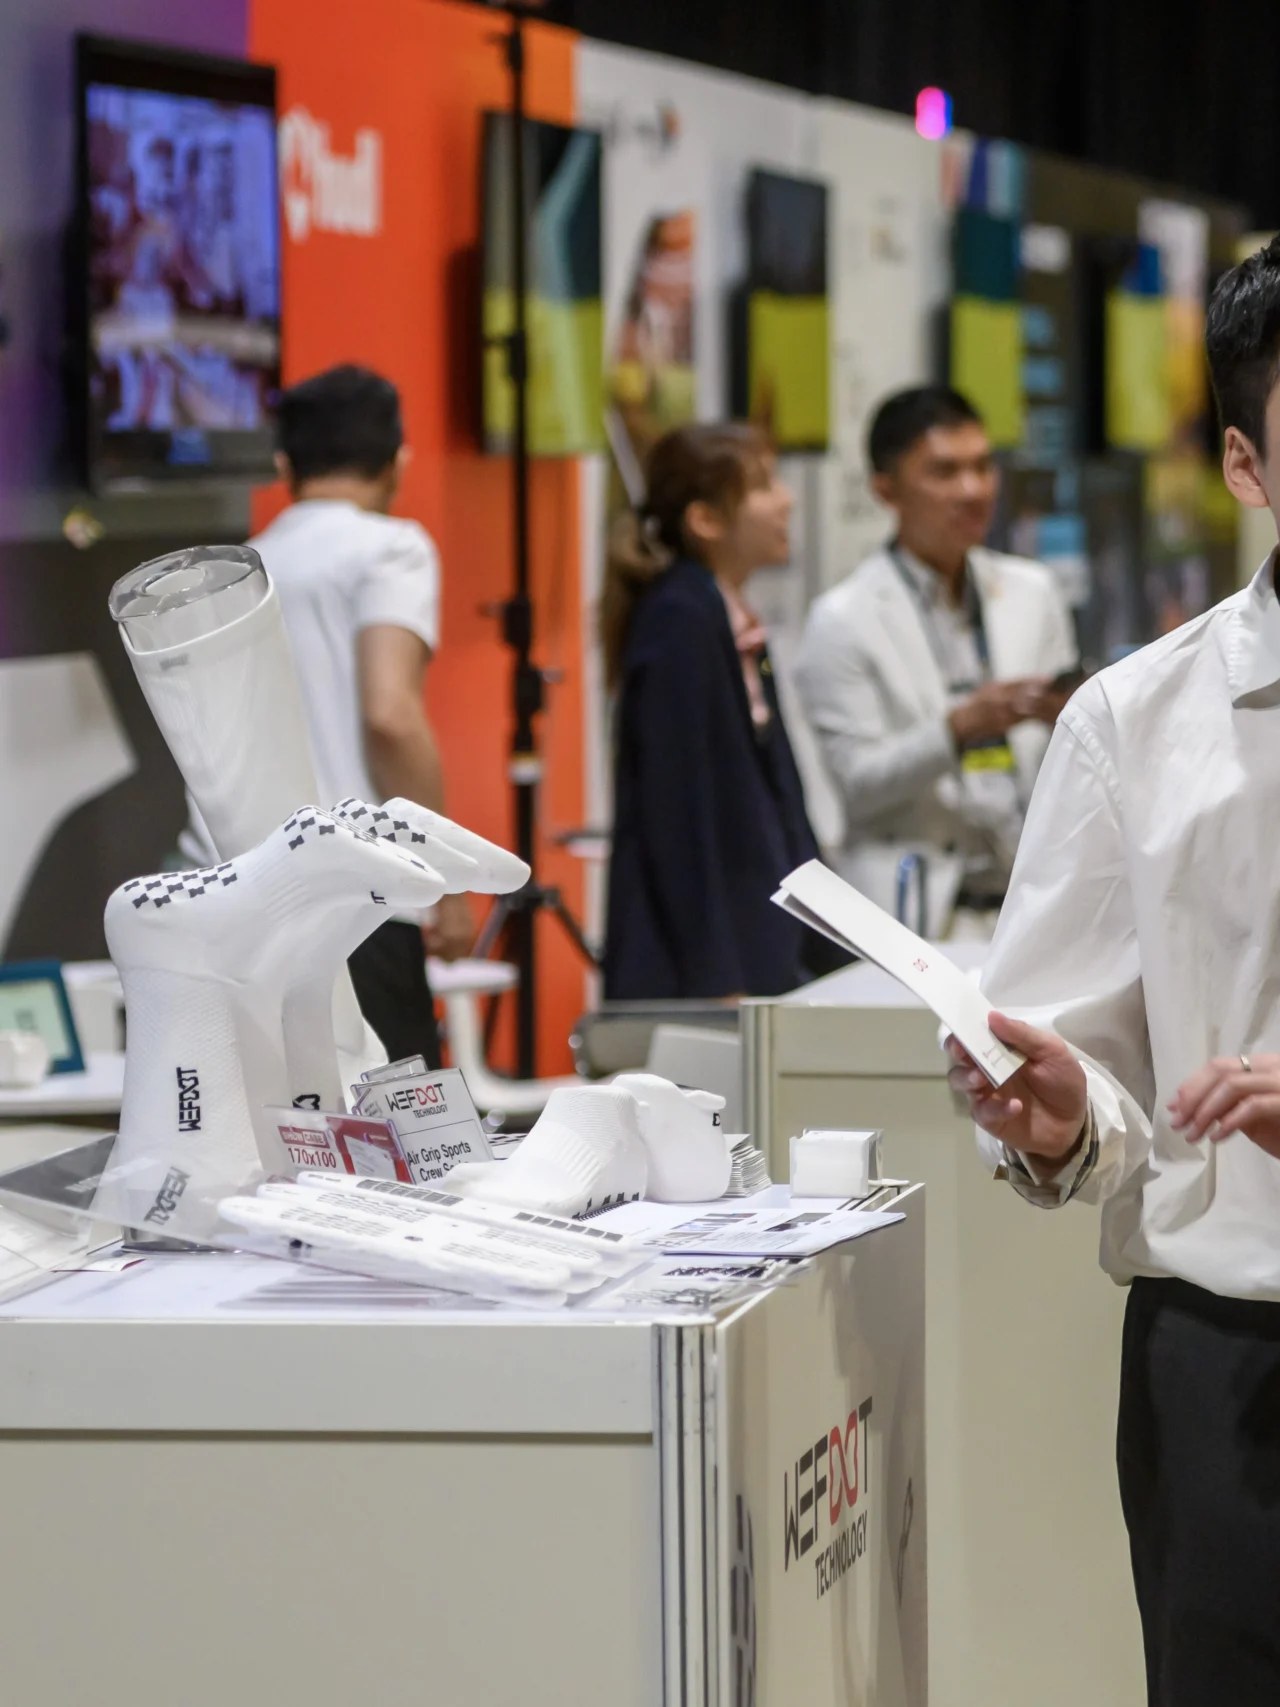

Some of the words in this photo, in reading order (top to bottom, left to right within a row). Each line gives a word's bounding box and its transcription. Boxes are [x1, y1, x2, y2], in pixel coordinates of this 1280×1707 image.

[413, 1104, 449, 1118] TECHNOLOGY
[288, 1147, 337, 1169] 170x100
[406, 1150, 420, 1166] Air
[420, 1147, 442, 1163] Grip
[441, 1140, 472, 1159] Sports
[420, 1163, 443, 1182] Crew
[814, 1510, 868, 1600] TECHNOLOGY
